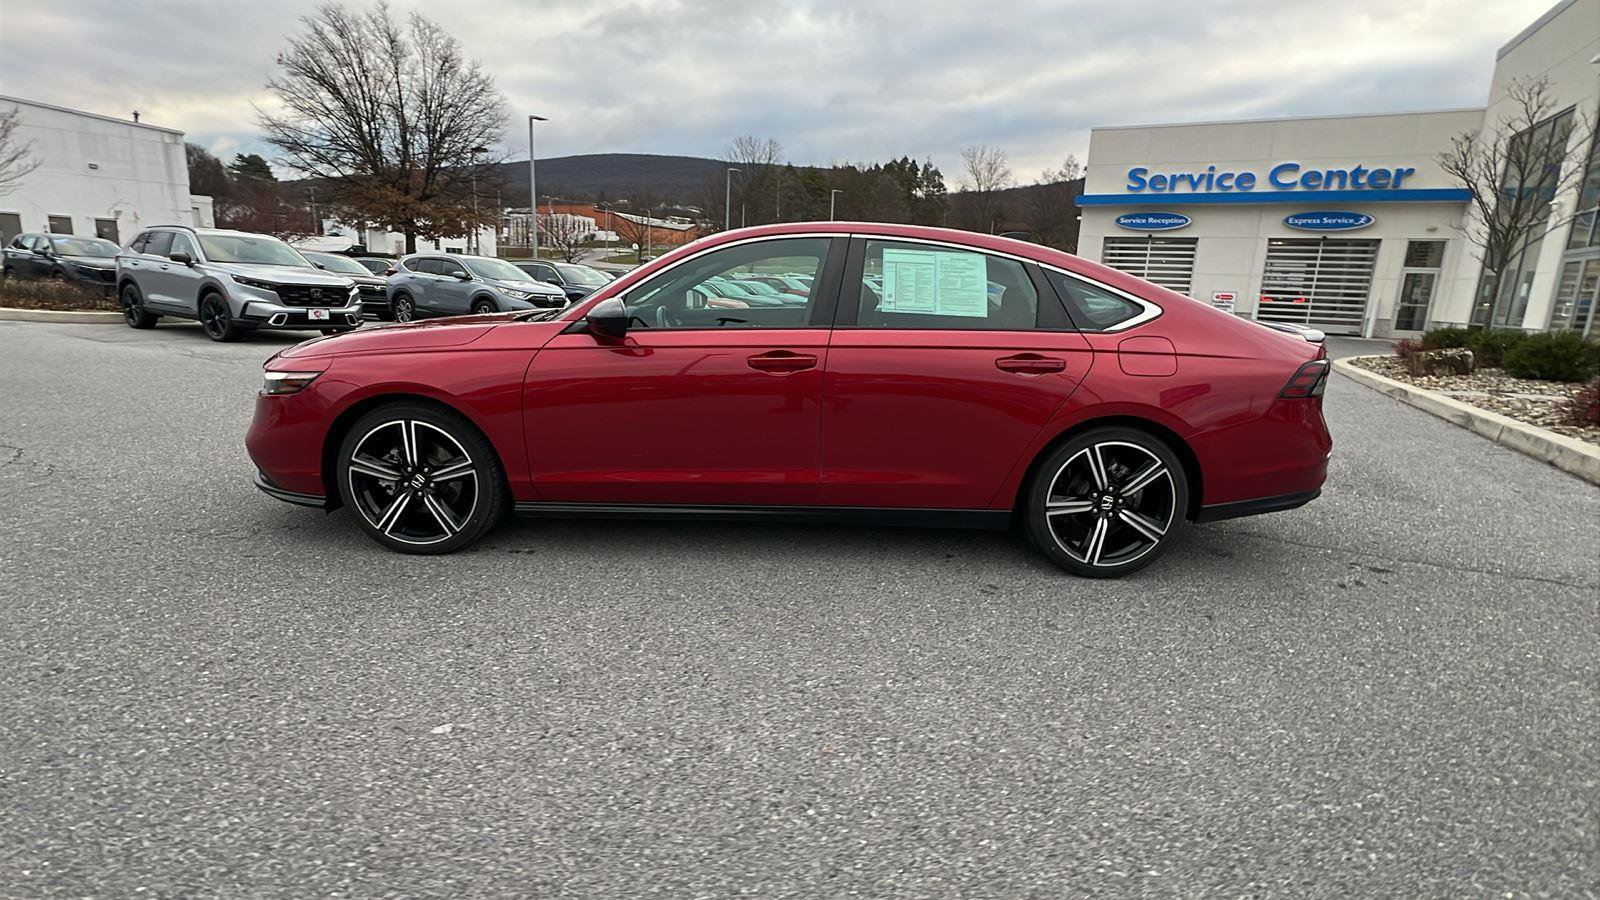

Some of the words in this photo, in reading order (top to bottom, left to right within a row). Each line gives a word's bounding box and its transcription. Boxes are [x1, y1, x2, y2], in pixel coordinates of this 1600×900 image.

[1126, 165, 1256, 192] Service
[1269, 162, 1416, 190] Center
[1147, 217, 1186, 225] Reception
[1288, 217, 1321, 226] Express
[1322, 216, 1355, 224] Service
